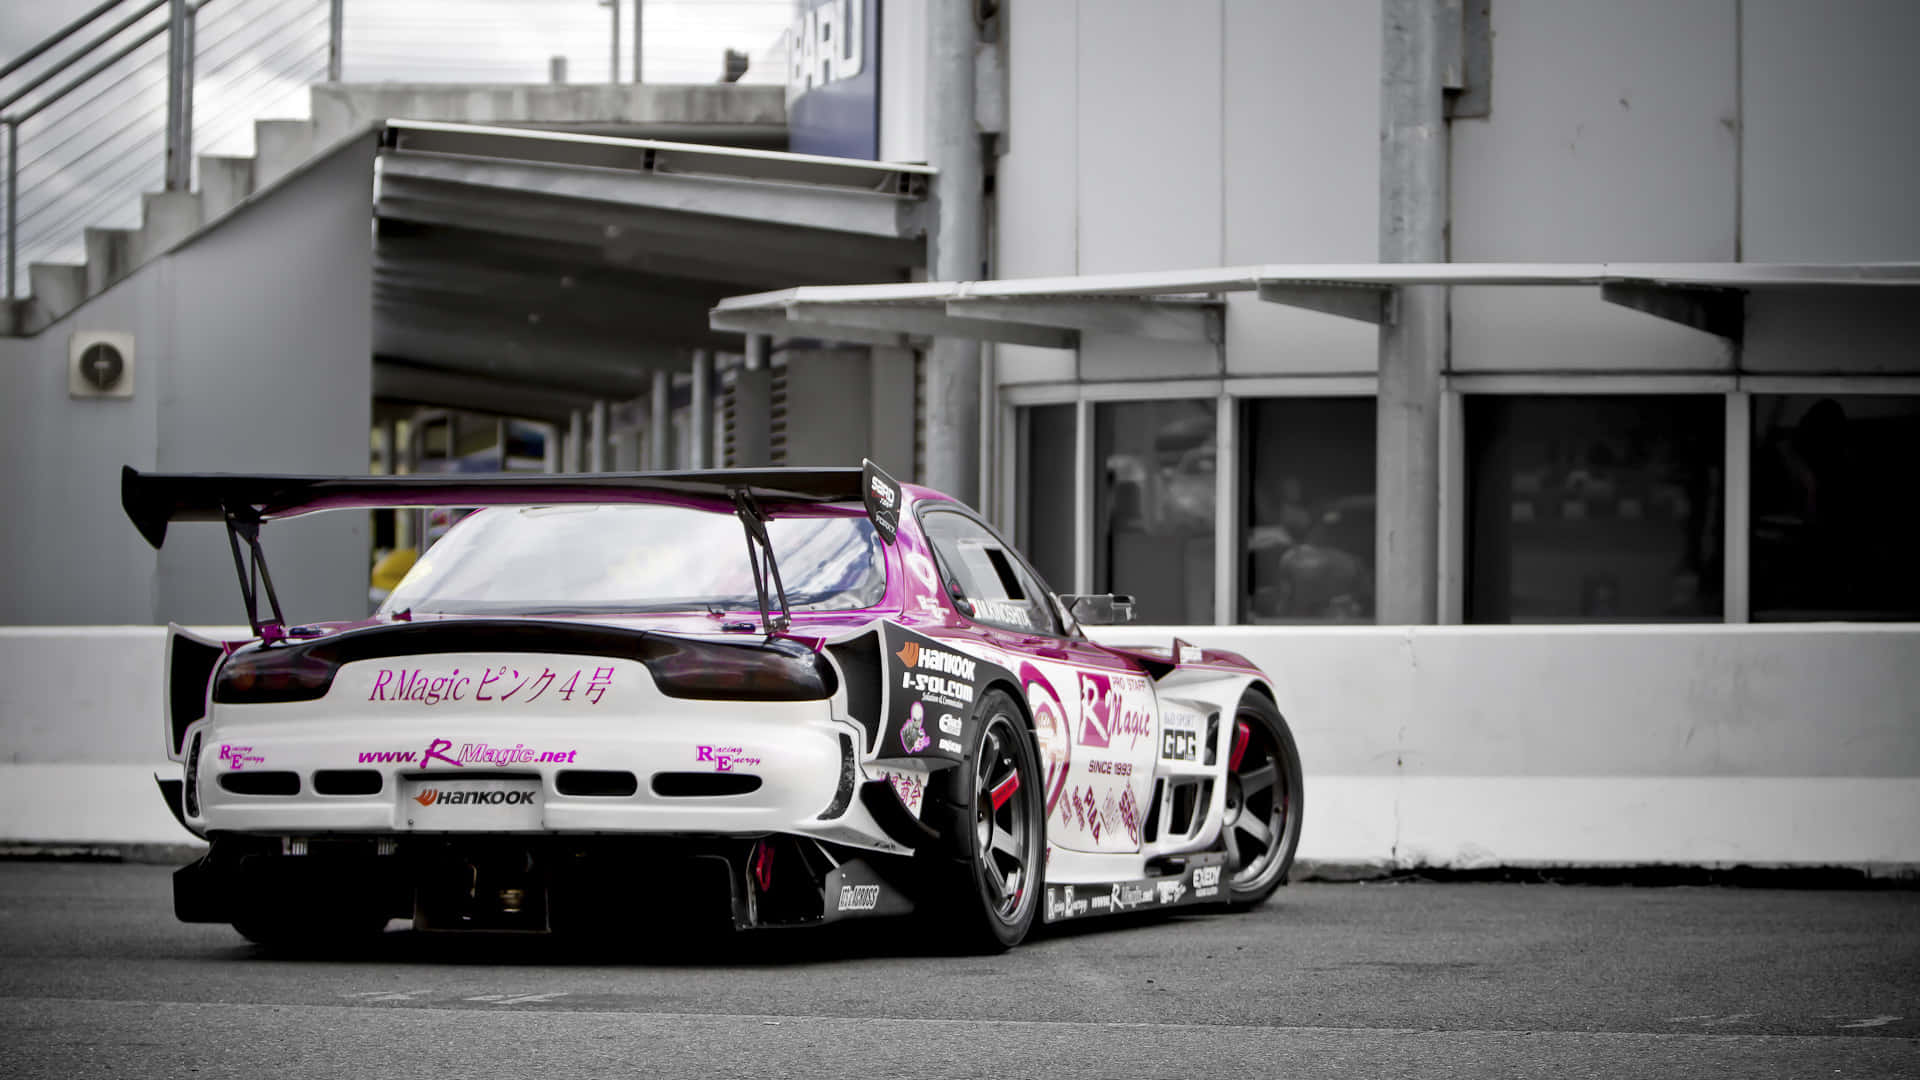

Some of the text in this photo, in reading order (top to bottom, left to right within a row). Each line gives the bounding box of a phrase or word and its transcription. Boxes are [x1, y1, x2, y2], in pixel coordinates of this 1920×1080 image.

[368, 668, 470, 705] RMagic
[696, 744, 742, 761] Racing
[1162, 729, 1196, 760] GCG
[715, 756, 760, 771] Energy
[1088, 760, 1132, 776] SINCE 1993
